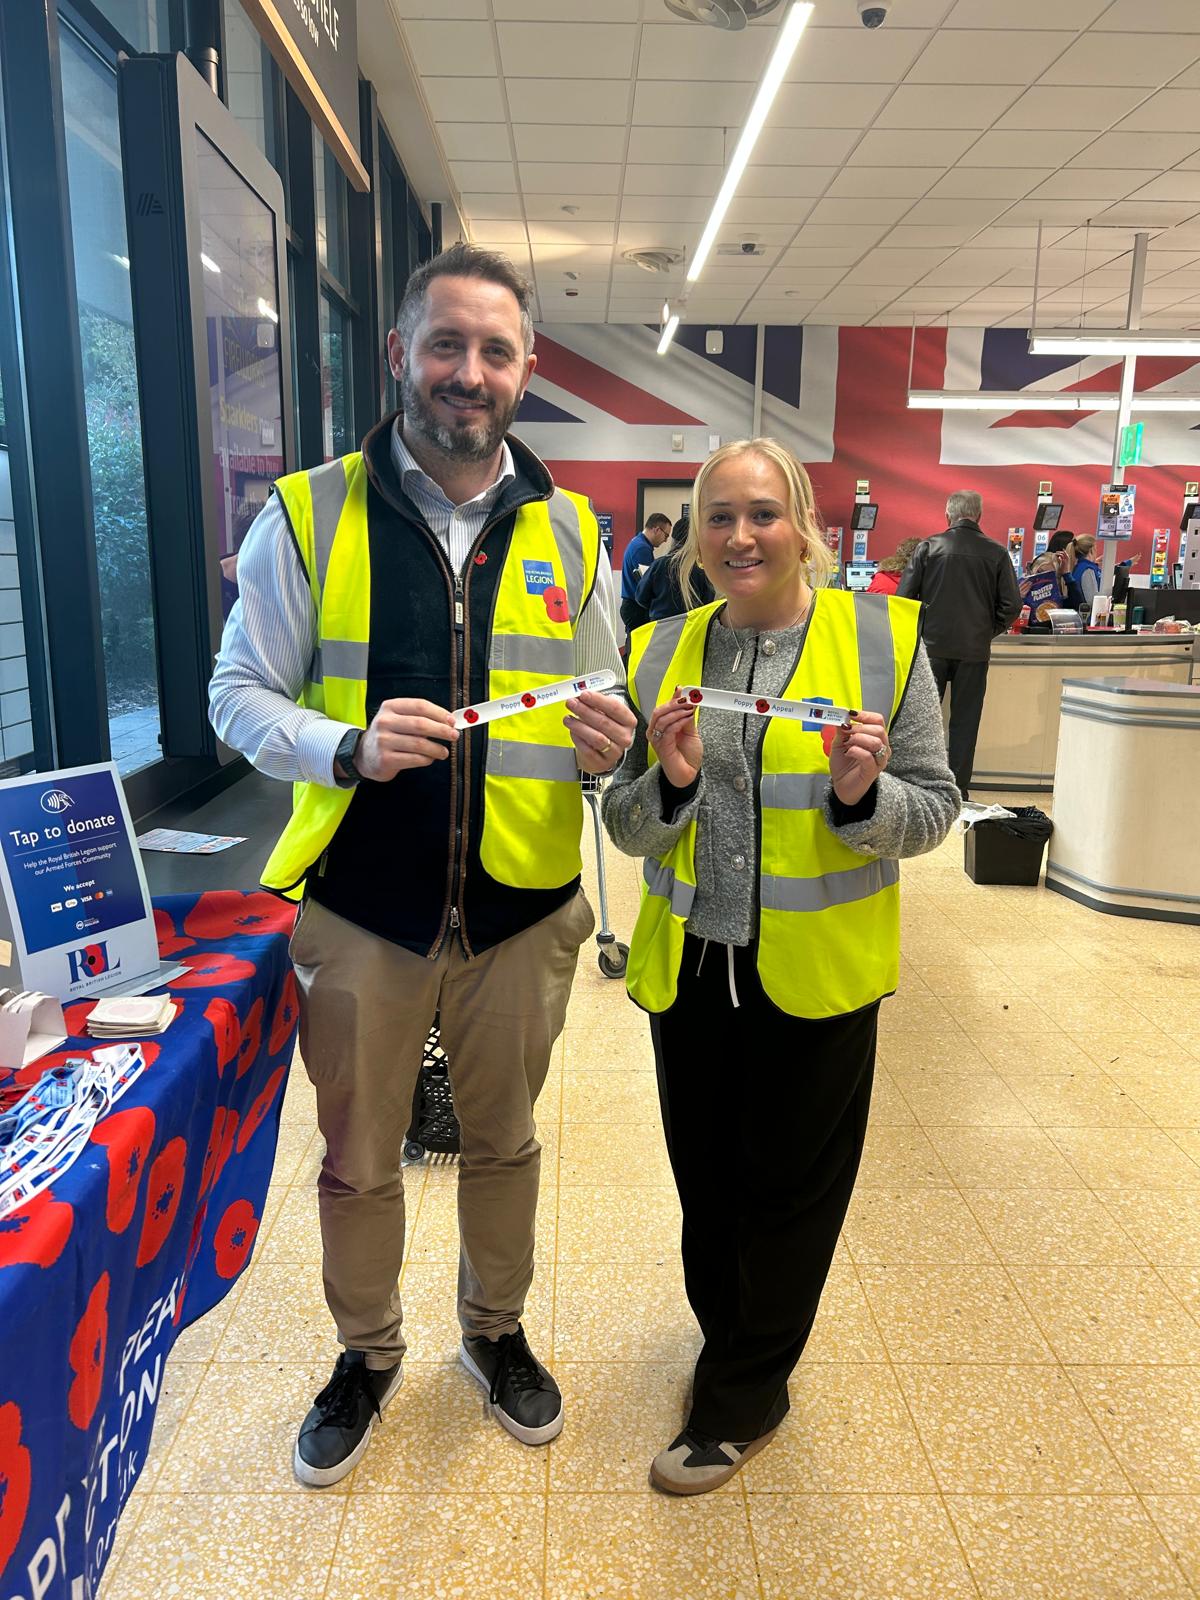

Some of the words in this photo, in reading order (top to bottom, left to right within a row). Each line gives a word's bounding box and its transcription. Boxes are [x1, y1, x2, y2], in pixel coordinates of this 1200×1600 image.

[526, 575, 554, 585] LEGION
[500, 701, 520, 710] Poppy
[536, 689, 559, 700] Appeal
[733, 698, 754, 707] Poppy
[771, 703, 794, 712] Appeal
[9, 830, 39, 847] Tap
[44, 827, 61, 839] to
[67, 815, 116, 834] donate
[23, 861, 37, 870] Help
[38, 858, 47, 866] the
[48, 855, 63, 865] Royal
[63, 851, 80, 860] British
[80, 847, 97, 857] Legion
[97, 842, 118, 852] support
[34, 868, 45, 876] our
[45, 864, 64, 873] Armed
[65, 860, 82, 868] Forces
[82, 852, 111, 864] Community
[76, 879, 95, 889] accept
[80, 895, 93, 903] VISA
